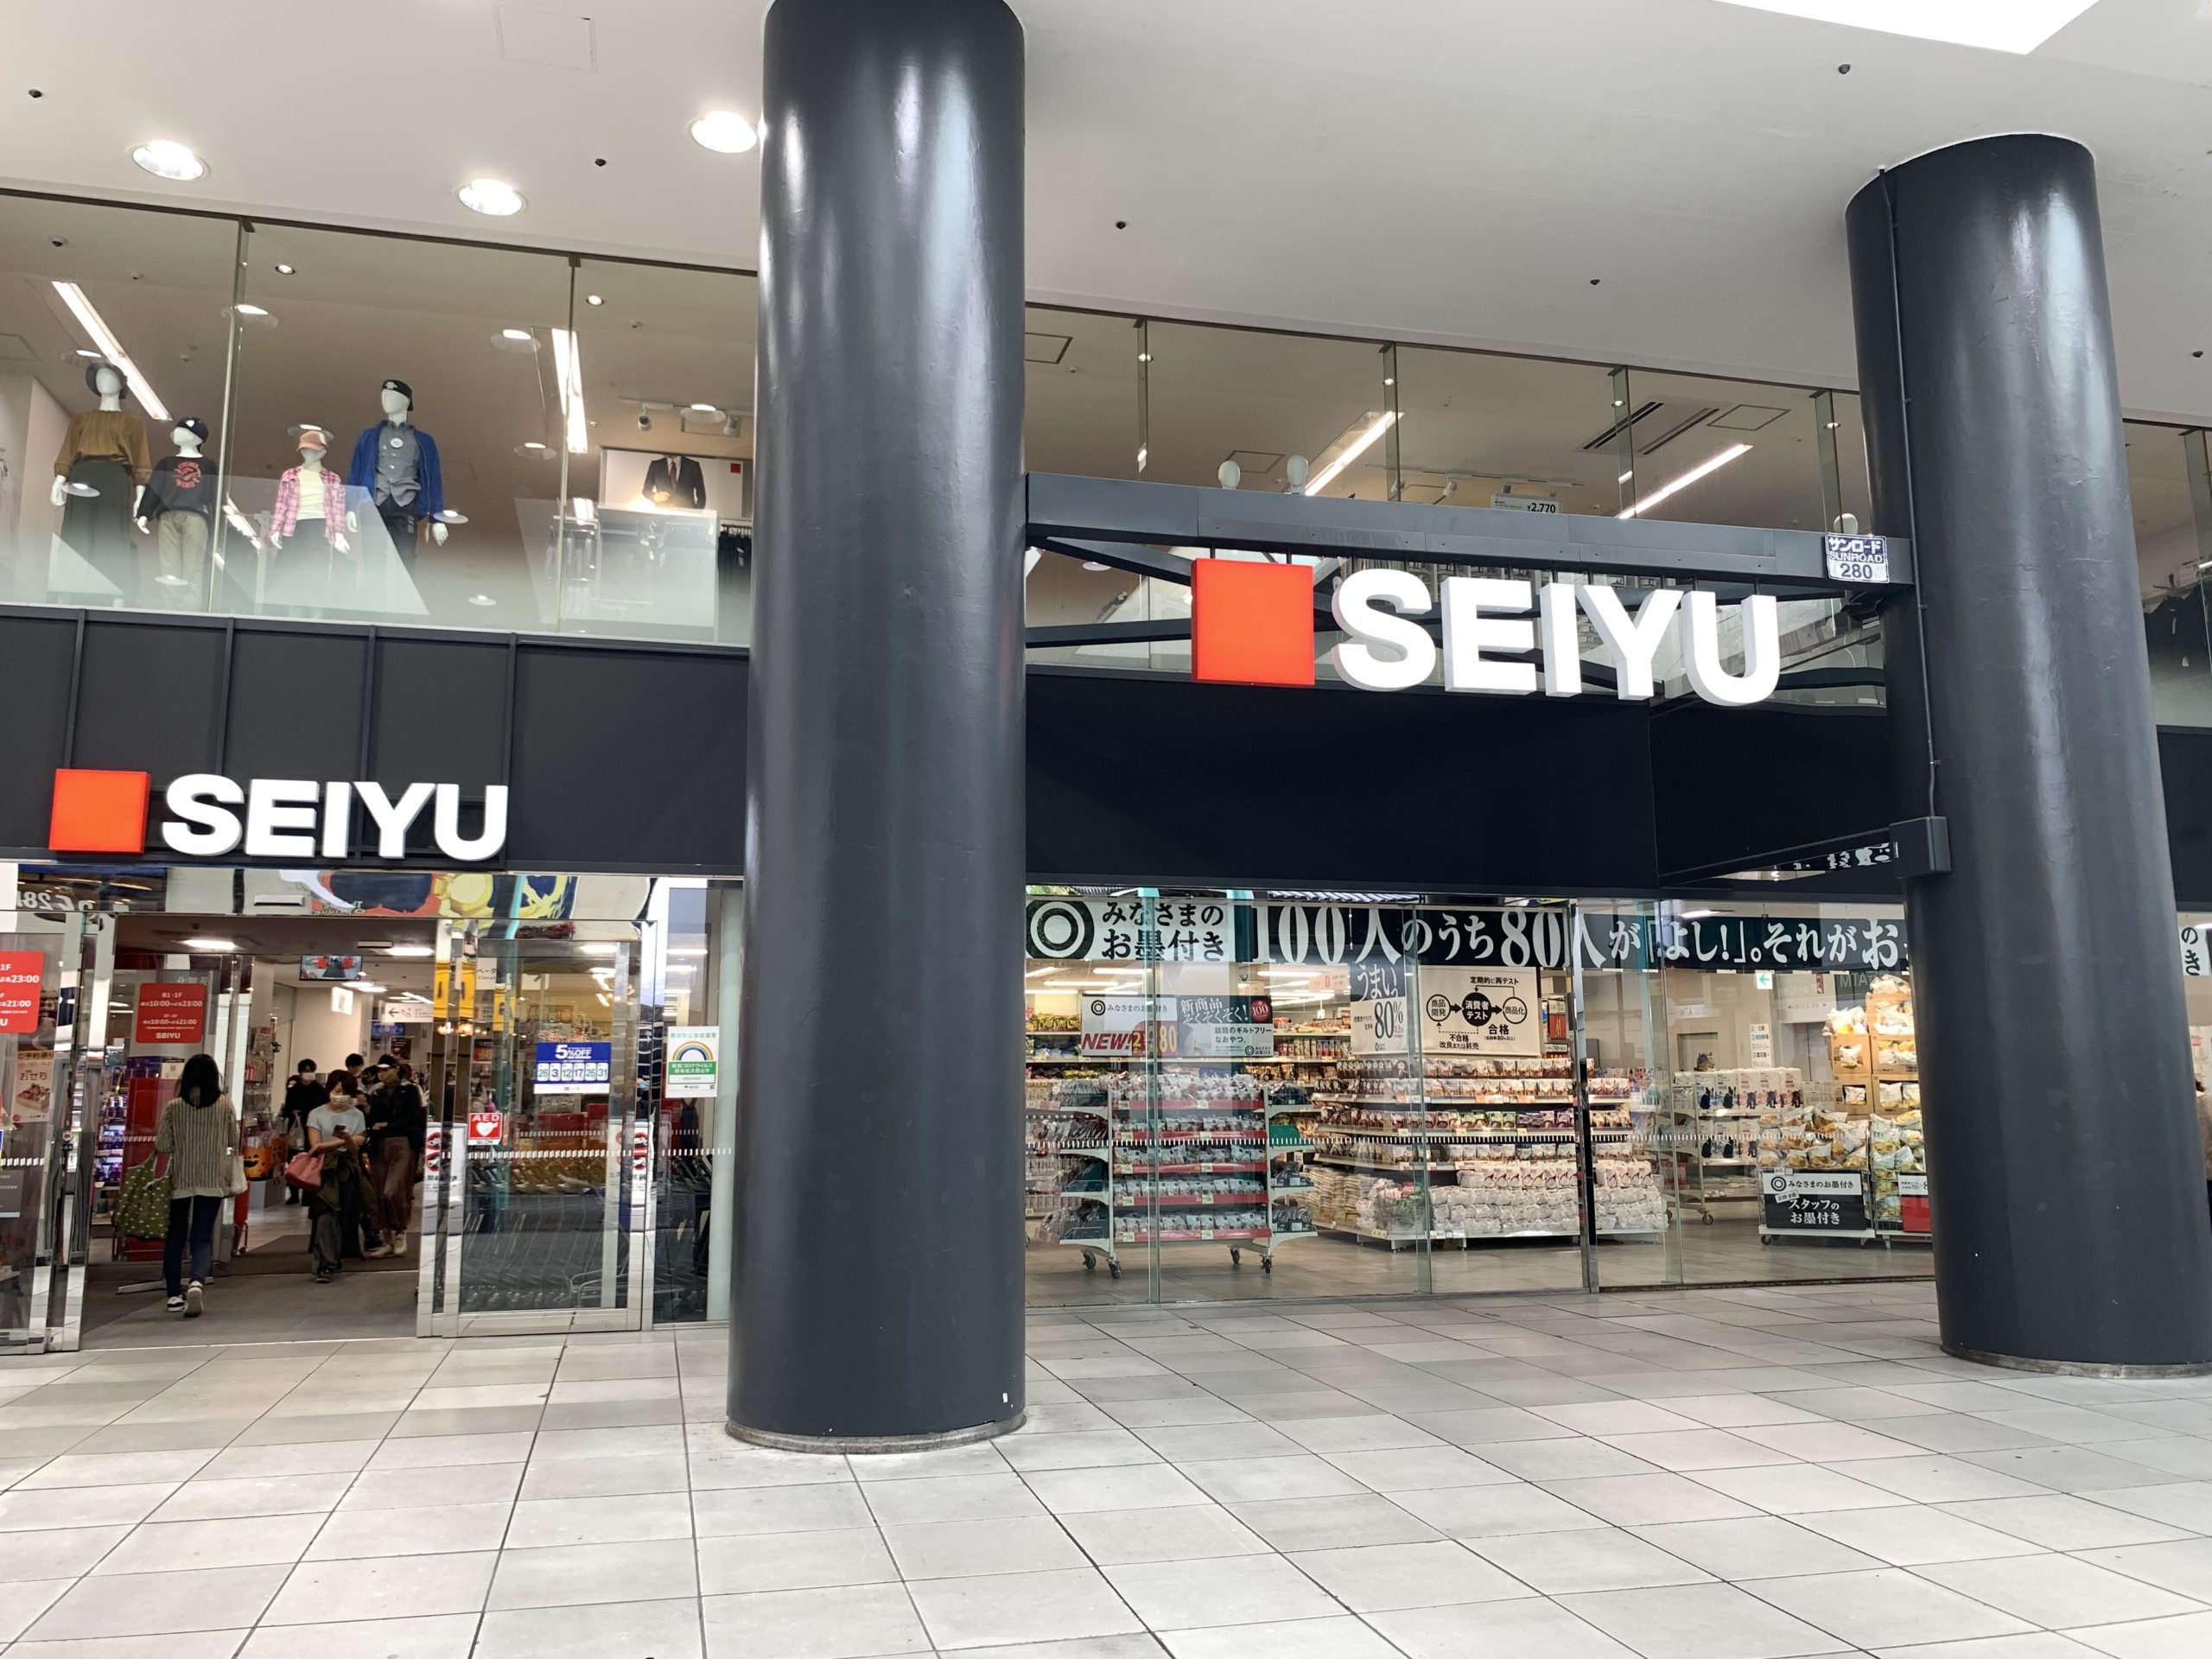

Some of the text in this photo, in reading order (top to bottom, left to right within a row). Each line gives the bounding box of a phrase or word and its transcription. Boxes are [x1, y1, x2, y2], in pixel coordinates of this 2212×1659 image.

[1828, 537, 1882, 554] サンロード
[1828, 551, 1884, 563] SUNROAD
[1840, 563, 1873, 579] 280
[1332, 568, 1781, 708] SEIYU
[161, 772, 509, 861] SEIYU
[1102, 902, 1224, 926] みなさまの
[1102, 930, 1225, 962] お墨付き
[1470, 976, 1520, 986] 定期的に再テスト
[1431, 999, 1446, 1008] 商品
[1465, 1000, 1490, 1010] 消費者
[1431, 1008, 1446, 1018] 開発
[1466, 1010, 1489, 1020] テスト
[1504, 1006, 1527, 1015] 商品化
[1374, 1001, 1404, 1039] 80%
[1214, 1026, 1272, 1035] 話題のギルトフリー
[1488, 1023, 1510, 1036] 合格
[1082, 1033, 1132, 1051] NEW!
[1448, 1033, 1471, 1043] 不合格
[1439, 1041, 1480, 1051] 改良または終売
[19, 1071, 48, 1081] おせち
[551, 1069, 559, 1077] 3
[563, 1069, 572, 1077] 12
[575, 1069, 584, 1077] 17
[1788, 1180, 1854, 1189] みなさまのお墨付き
[1789, 1198, 1840, 1211] スタッフの
[1790, 1211, 1840, 1225] お墨付き
